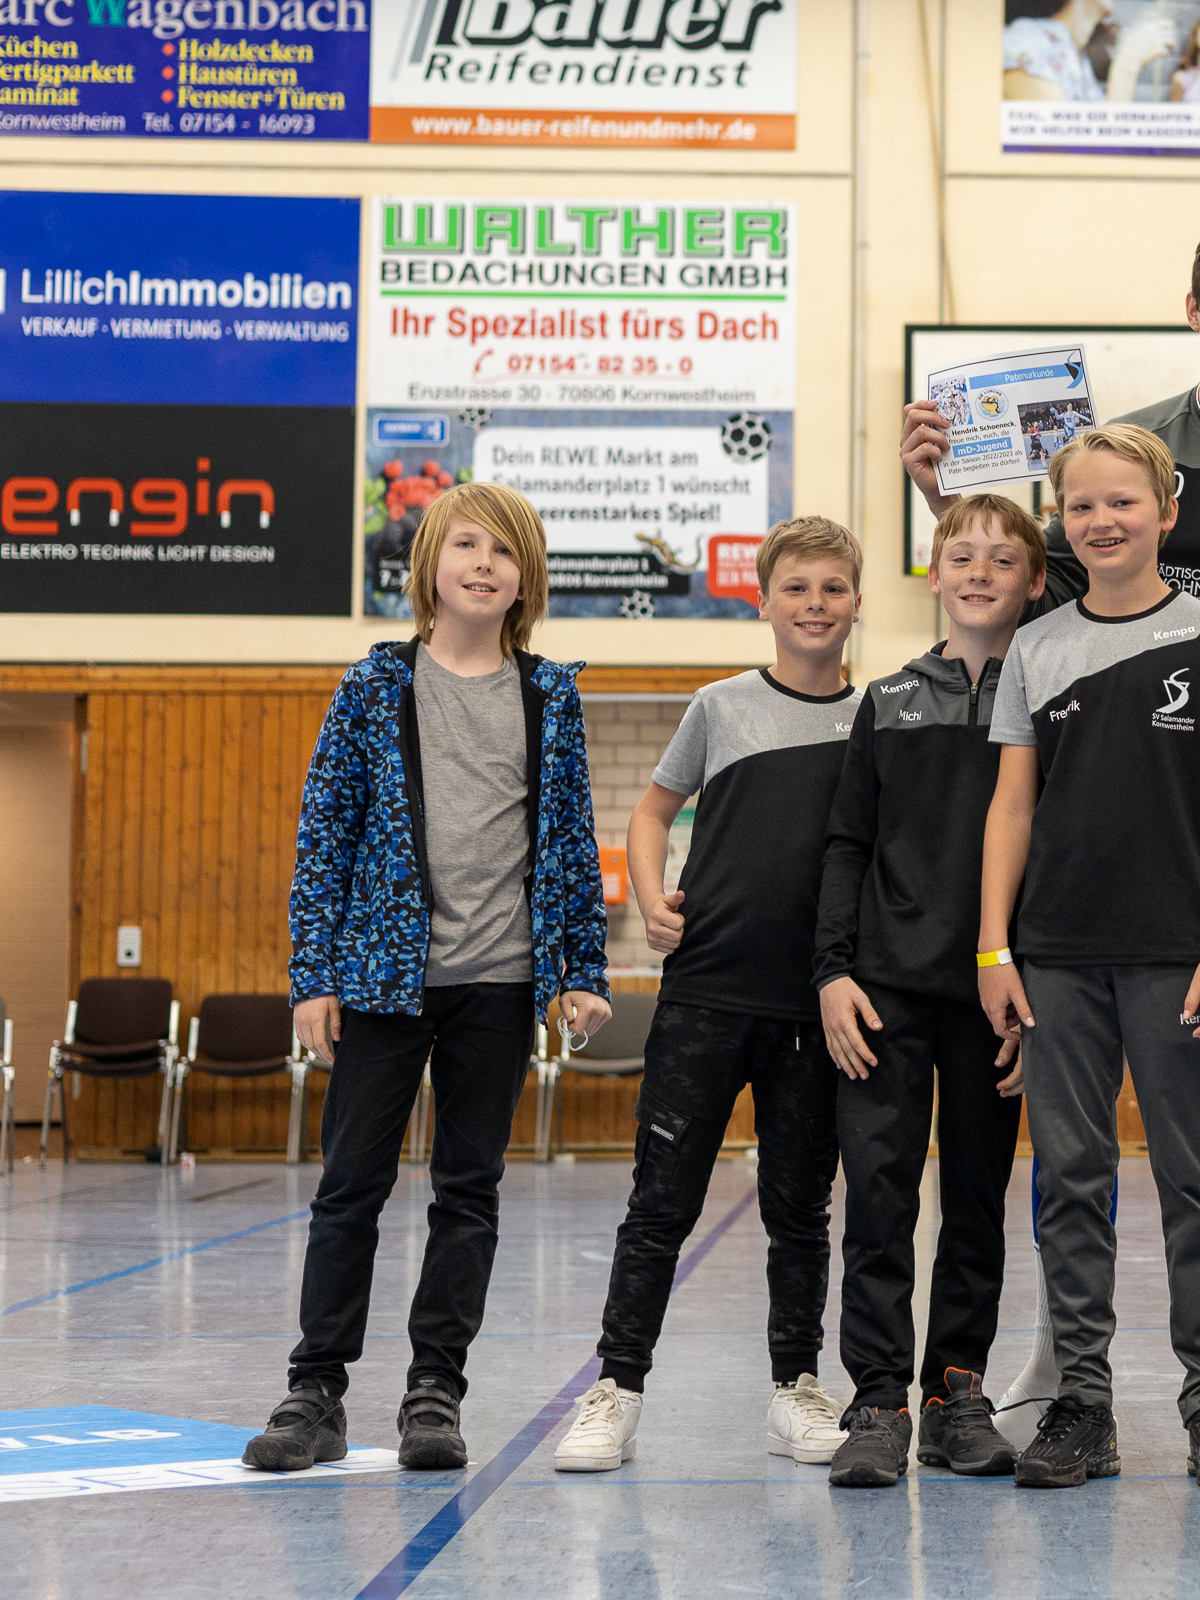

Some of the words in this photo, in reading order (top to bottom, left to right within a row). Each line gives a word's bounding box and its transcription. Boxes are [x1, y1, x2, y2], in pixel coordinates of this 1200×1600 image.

[178, 38, 314, 63] Holzdecken
[0, 59, 137, 88] ertigparkett
[178, 62, 298, 86] Haustüren
[424, 52, 751, 88] Reifendienst
[180, 114, 235, 133] 07154
[259, 114, 315, 134] 16093
[411, 114, 757, 141] www.bauer-reifenundmehr.de
[382, 203, 788, 259] WALTHER
[381, 260, 666, 287] BEDACHUNGEN
[679, 264, 787, 288] GMBH
[21, 268, 352, 310] LillichImmobilien
[21, 317, 99, 337] VERKAUF
[110, 318, 222, 340] VERMIETUNG
[233, 320, 349, 342] VERWALTUNG
[391, 308, 436, 337] Ihr
[447, 309, 608, 345] Spezialist
[621, 310, 684, 340] fürs
[699, 311, 778, 341] Dach
[508, 355, 575, 374] 07154
[1005, 368, 1054, 383] Patenurkunde
[622, 386, 757, 404] Kornwestheim
[952, 427, 978, 436] Hendrik
[980, 421, 1017, 431] Schoeneck,
[491, 446, 534, 467] Dein
[541, 446, 599, 467] REWE
[606, 447, 663, 467] Markt
[670, 450, 699, 467] am
[957, 440, 1009, 456] mD-Jugend
[962, 457, 981, 465] Saison
[982, 450, 1013, 460] 2022/2023
[948, 466, 962, 474] Pate
[963, 461, 991, 472] begleiten
[673, 474, 751, 496] wünscht
[1, 457, 275, 537] engin
[539, 502, 662, 521] eerenstarkes
[668, 503, 721, 526] Spiel!
[0, 544, 78, 560] ELEKTRO
[81, 544, 154, 561] TECHNIK
[158, 546, 206, 562] LICHT
[210, 546, 275, 562] DESIGN
[1153, 625, 1196, 641] Kempa
[880, 679, 920, 694] Kempa
[898, 709, 922, 721] Michi
[1152, 712, 1160, 720] SV
[1160, 714, 1195, 724] Salamander
[1151, 720, 1195, 731] Kornwestheim
